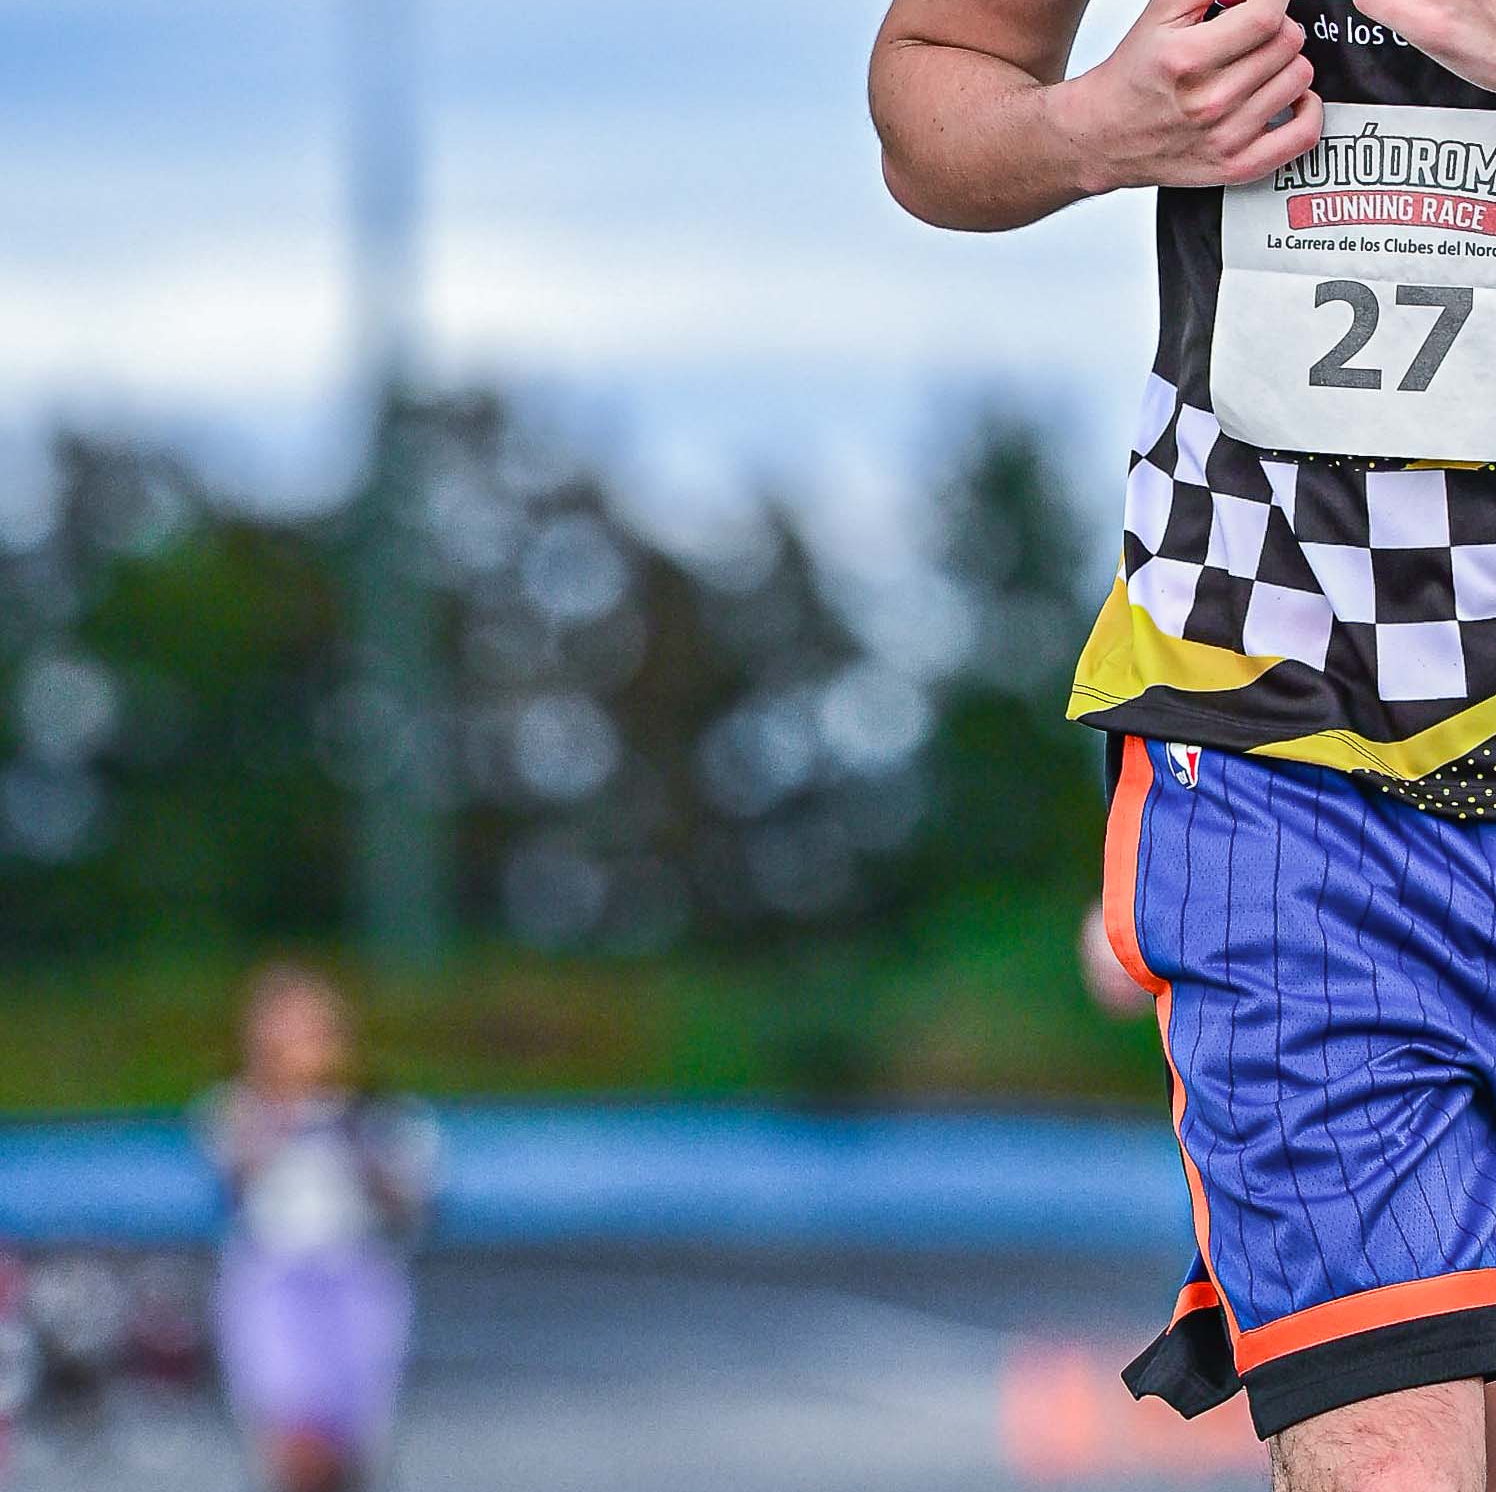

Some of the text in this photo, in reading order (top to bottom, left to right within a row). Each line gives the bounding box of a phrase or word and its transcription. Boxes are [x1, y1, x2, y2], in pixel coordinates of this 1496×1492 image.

[1314, 14, 1338, 42] de
[1347, 16, 1384, 45] los
[1311, 194, 1487, 230] RUNNING RACE
[1267, 234, 1282, 249] La
[1285, 236, 1336, 251] Carrera
[1339, 236, 1356, 251] de
[1360, 237, 1381, 252] los
[1384, 238, 1434, 254] Clubes
[1437, 240, 1461, 256] del
[1308, 279, 1475, 392] 27
